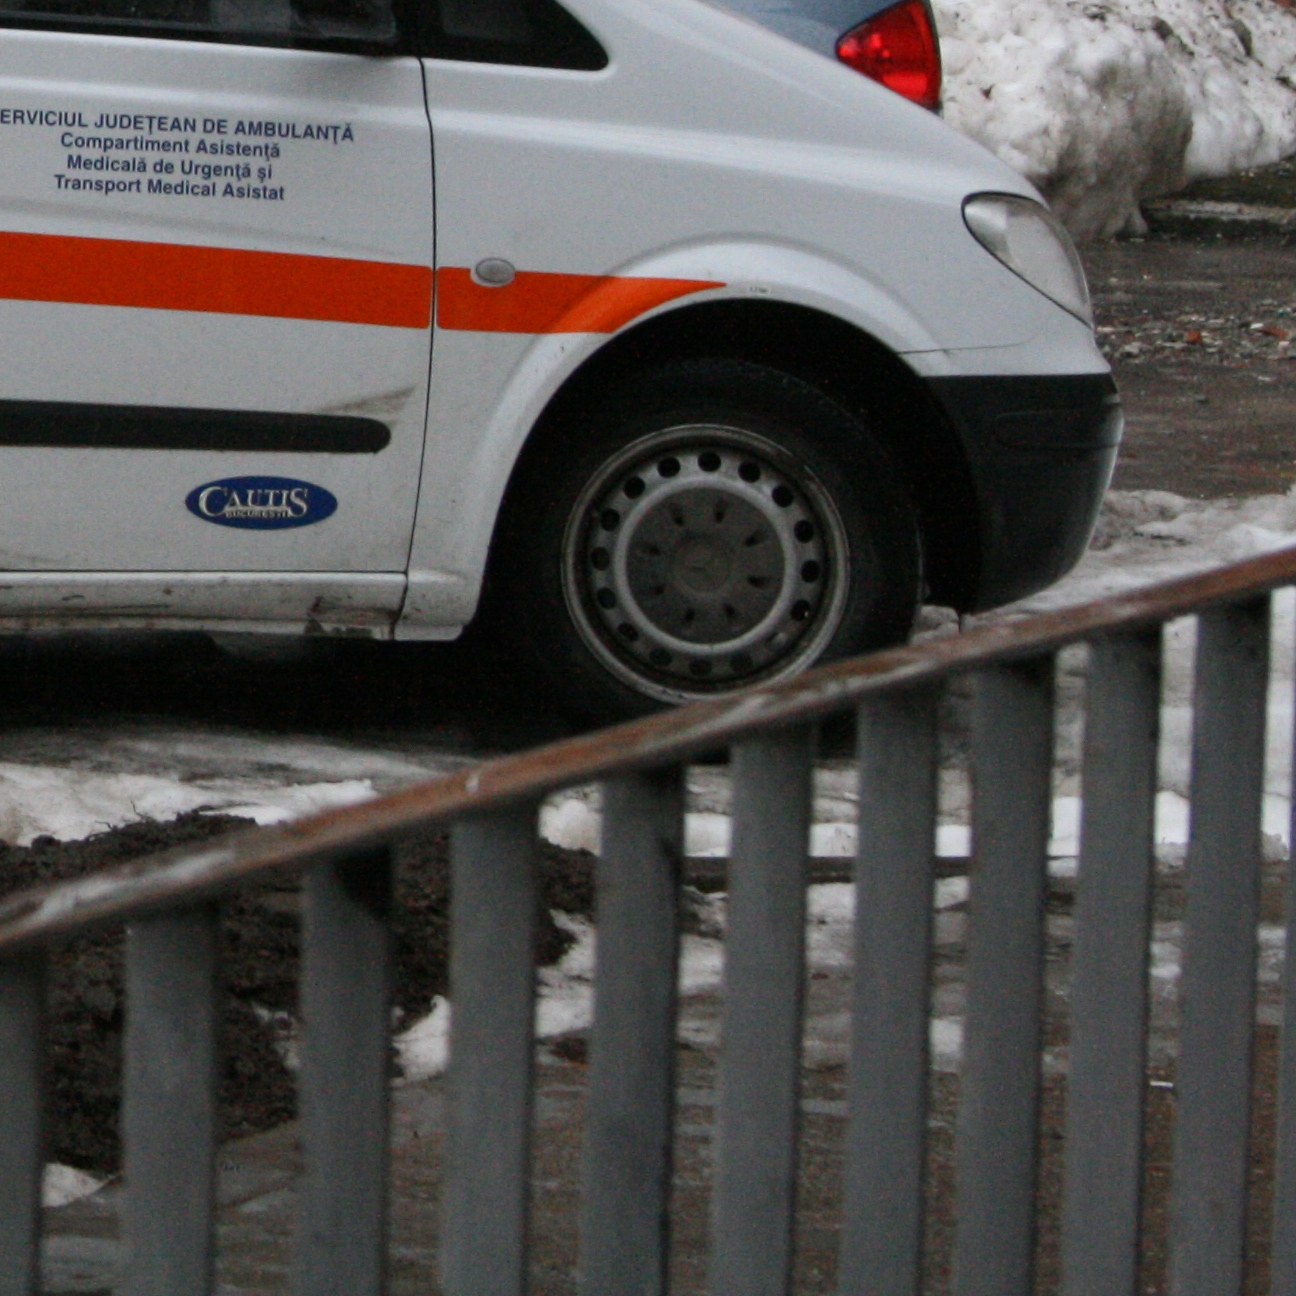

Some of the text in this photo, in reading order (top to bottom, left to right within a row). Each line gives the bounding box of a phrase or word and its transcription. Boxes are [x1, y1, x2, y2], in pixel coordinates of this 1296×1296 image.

[202, 118, 228, 135] DE
[60, 132, 190, 152] Compartiment
[67, 154, 147, 173] Medicală
[153, 158, 175, 175] de
[54, 174, 285, 200] Transport Medical Asistat
